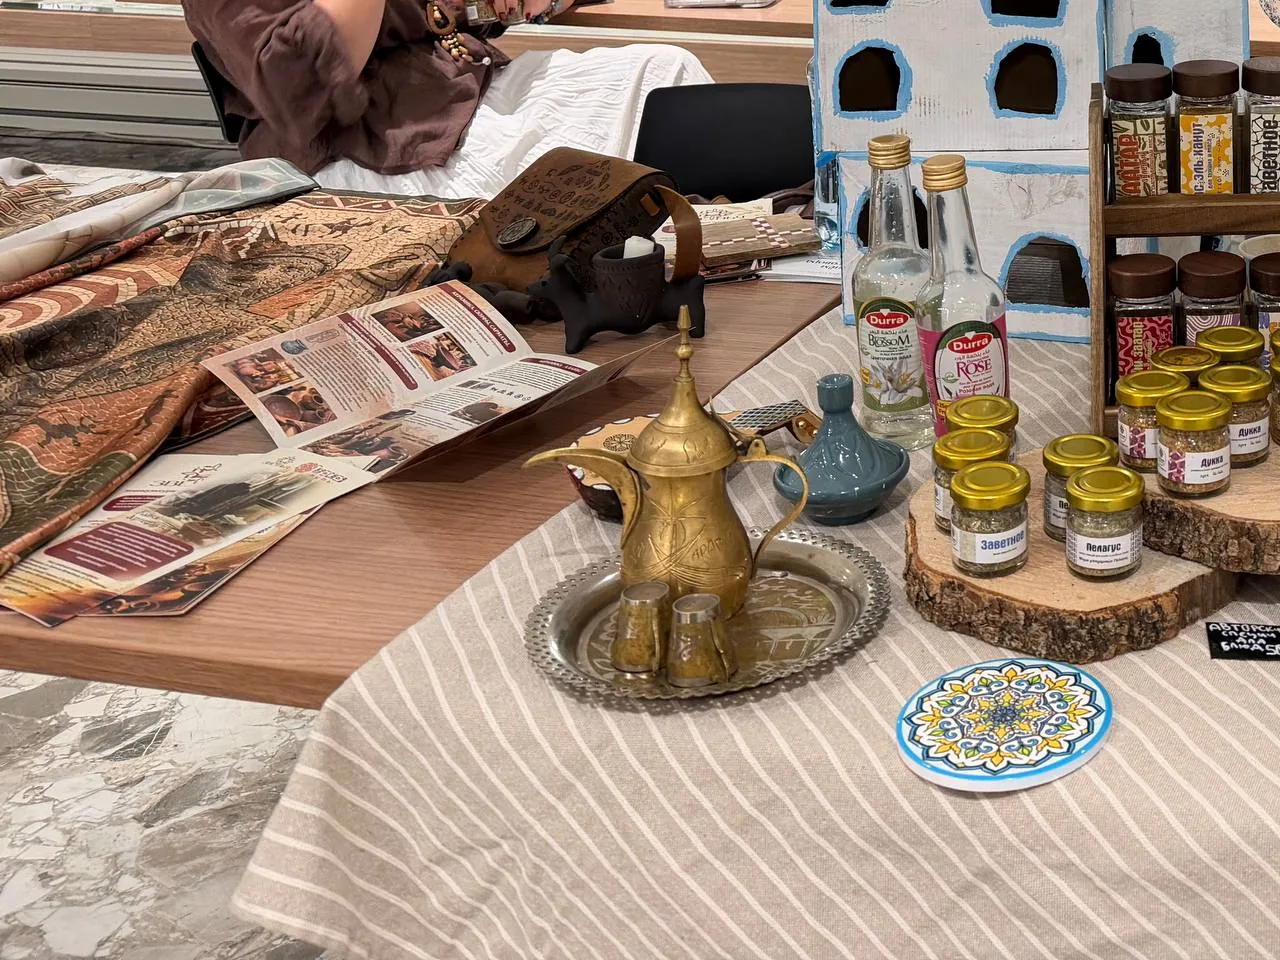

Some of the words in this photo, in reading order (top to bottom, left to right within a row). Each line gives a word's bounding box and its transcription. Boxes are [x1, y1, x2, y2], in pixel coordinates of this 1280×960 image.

[1262, 119, 1279, 192] аветное
[1118, 134, 1141, 195] ААТАР
[869, 315, 904, 326] Durra
[952, 337, 988, 351] Durra
[956, 358, 993, 382] ROSE
[1238, 425, 1262, 438] Дукка
[1200, 455, 1224, 469] Дукка
[980, 530, 1025, 550] Заветное
[1086, 542, 1122, 553] Пелагус
